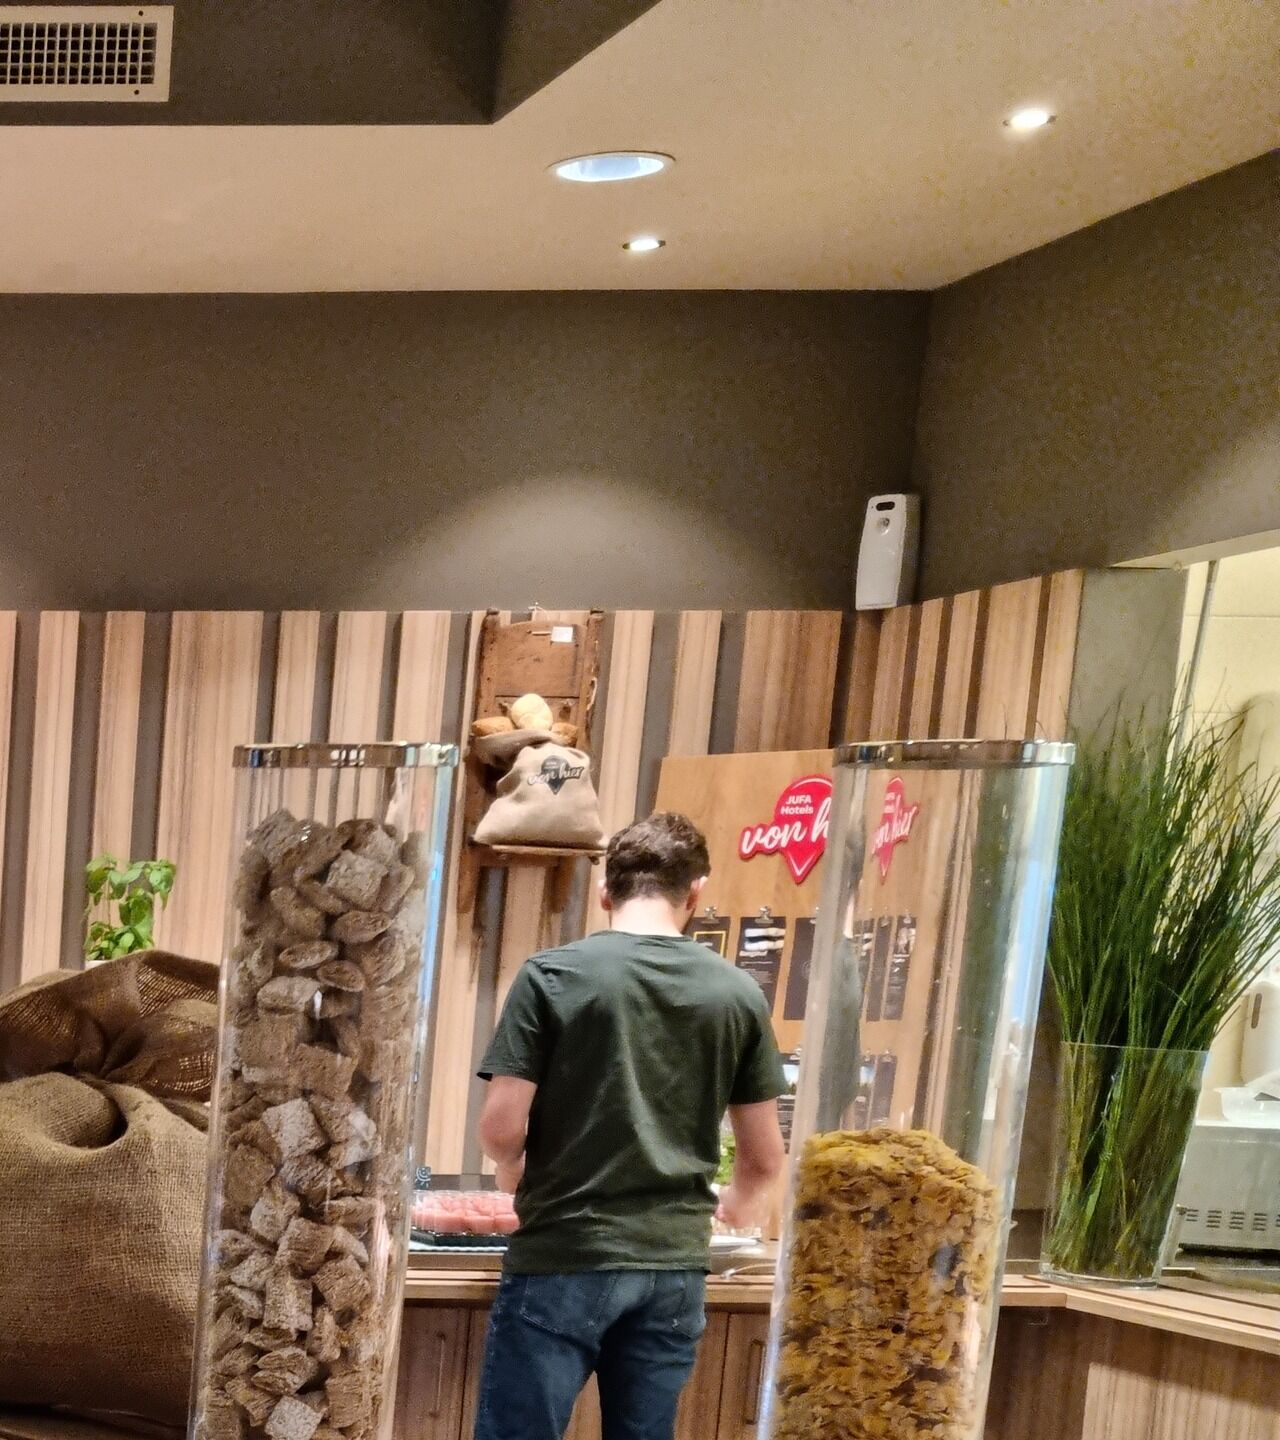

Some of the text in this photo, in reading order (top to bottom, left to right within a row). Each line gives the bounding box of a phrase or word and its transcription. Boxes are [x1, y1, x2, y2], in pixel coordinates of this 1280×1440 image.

[785, 795, 812, 805] JUFA
[780, 805, 814, 815] Hotels
[741, 820, 808, 854] von
